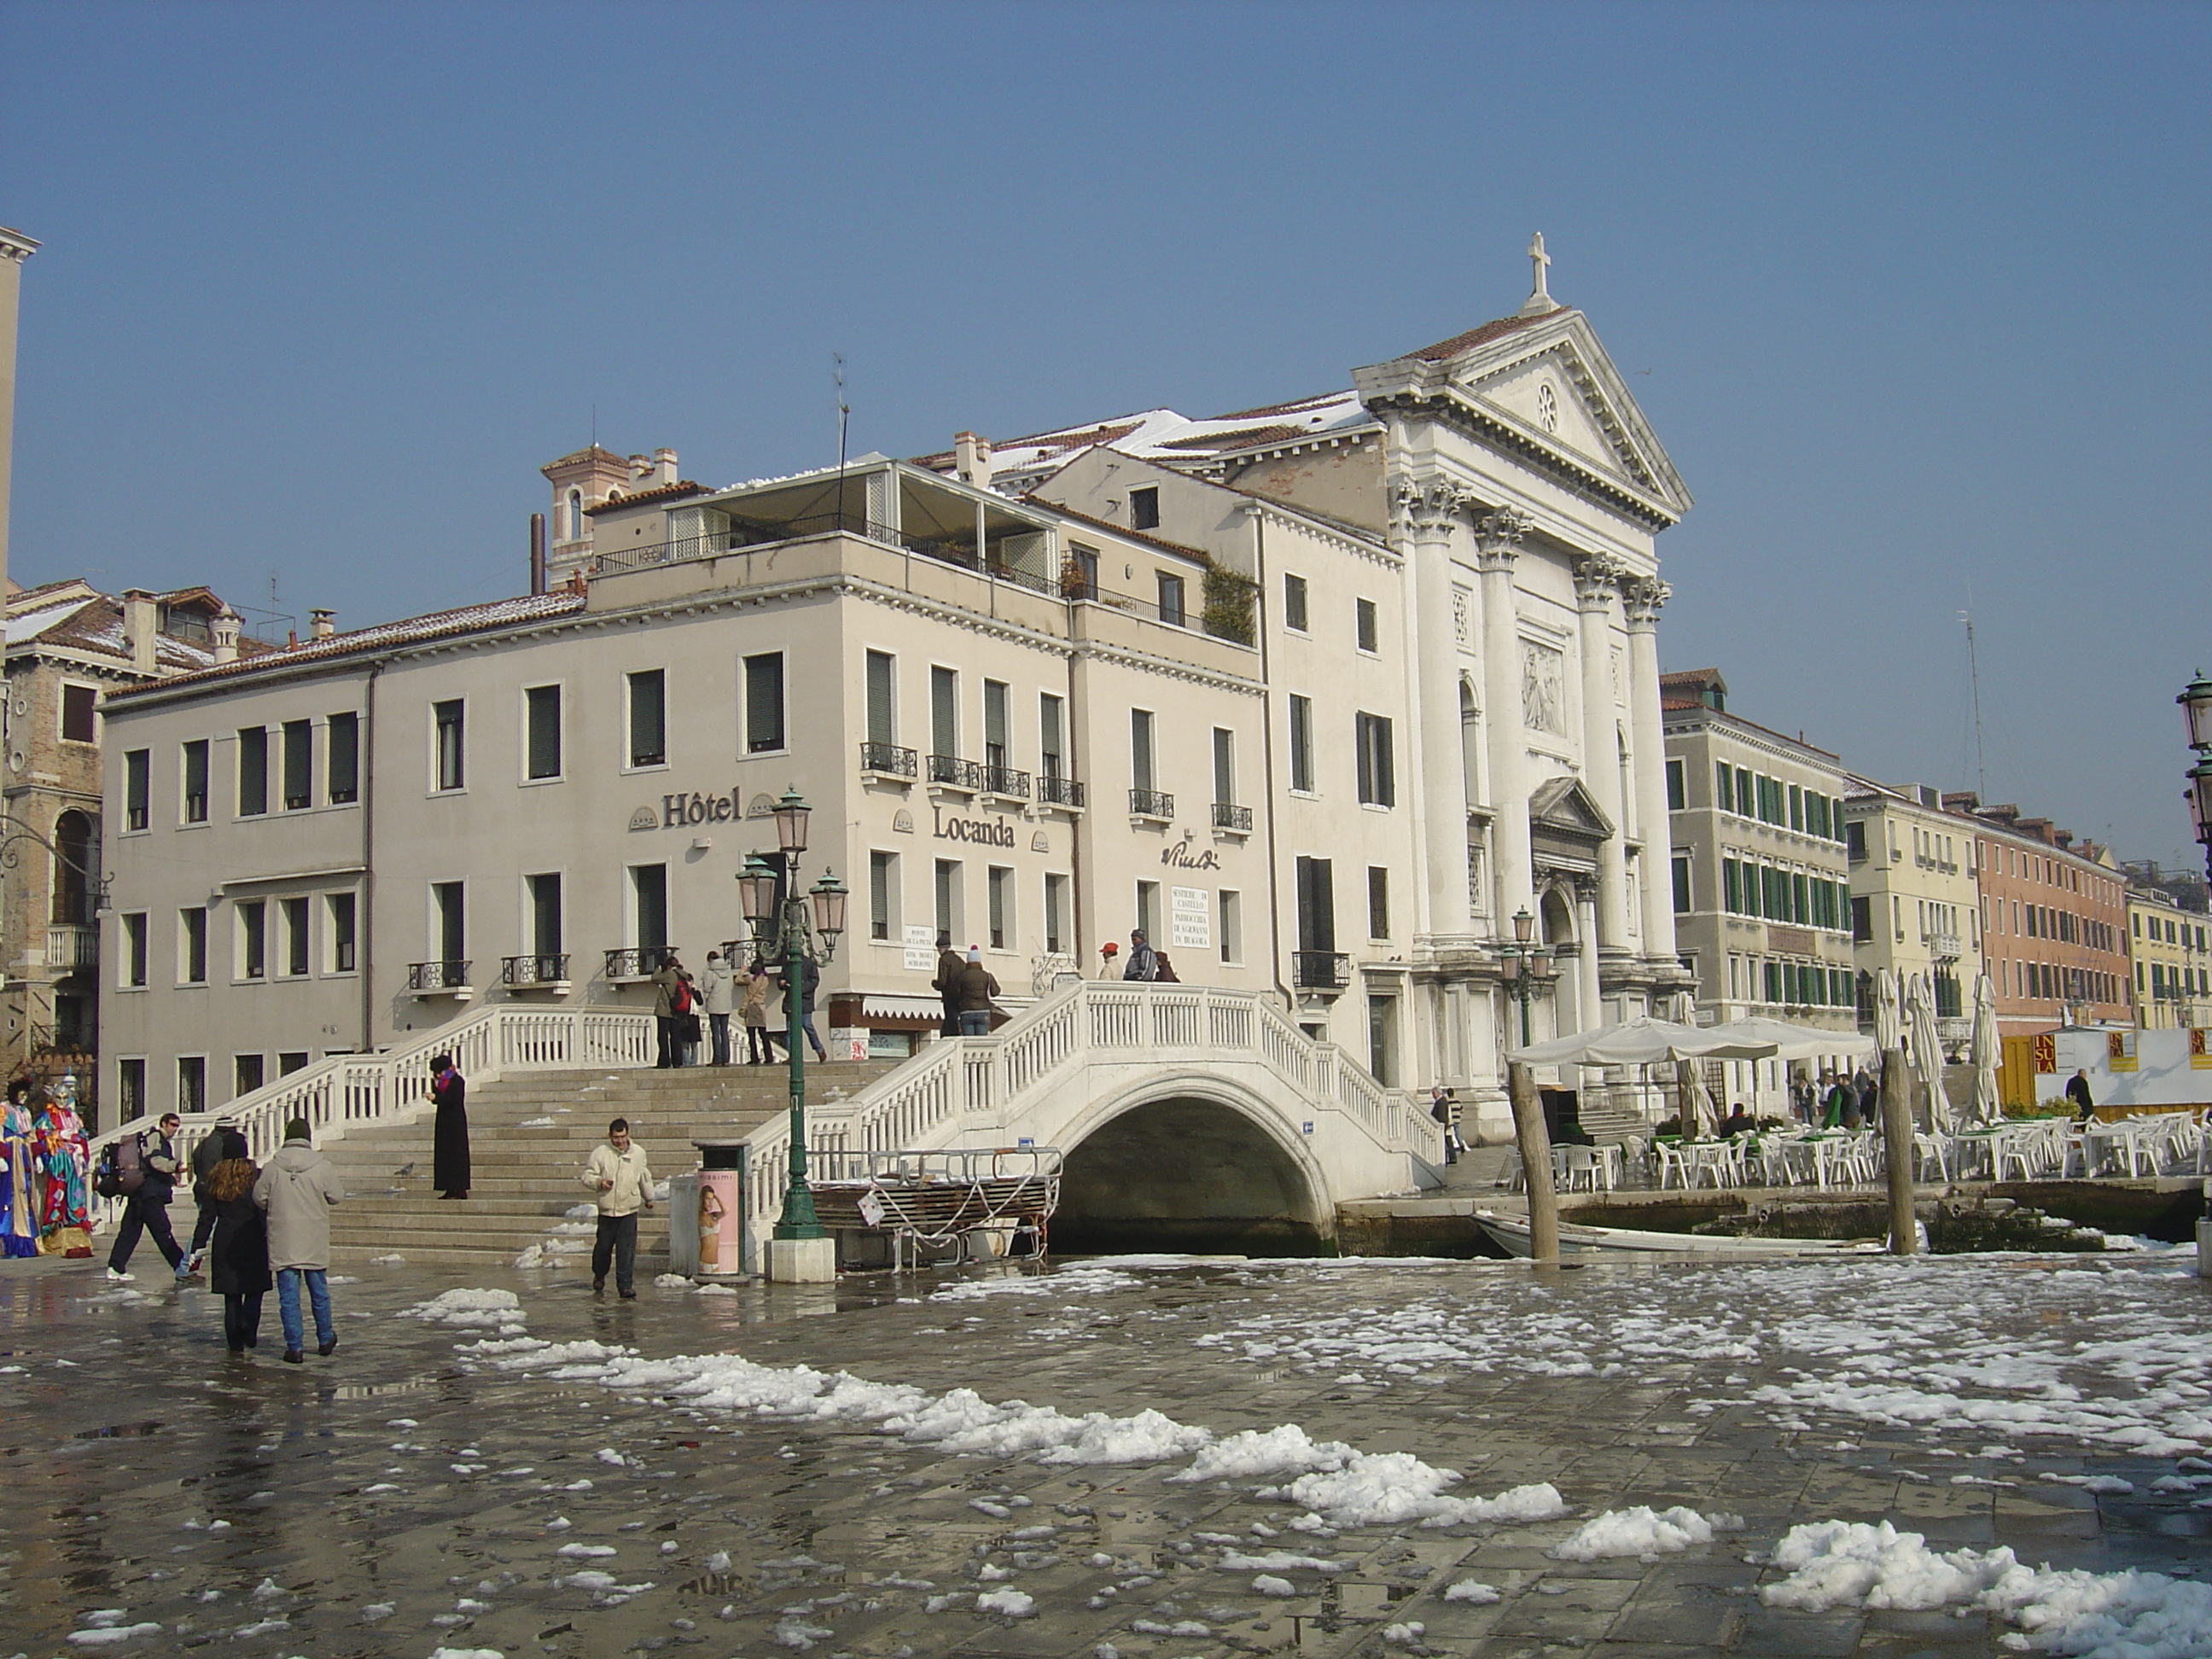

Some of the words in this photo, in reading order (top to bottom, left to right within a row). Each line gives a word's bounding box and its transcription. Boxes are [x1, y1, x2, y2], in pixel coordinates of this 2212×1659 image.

[662, 785, 742, 827] Hôtel
[933, 805, 1016, 848] Locanda
[1178, 900, 1204, 909] CASTELLO
[2035, 1035, 2054, 1048] IN
[2034, 1048, 2054, 1061] SU
[2036, 1061, 2056, 1074] LA
